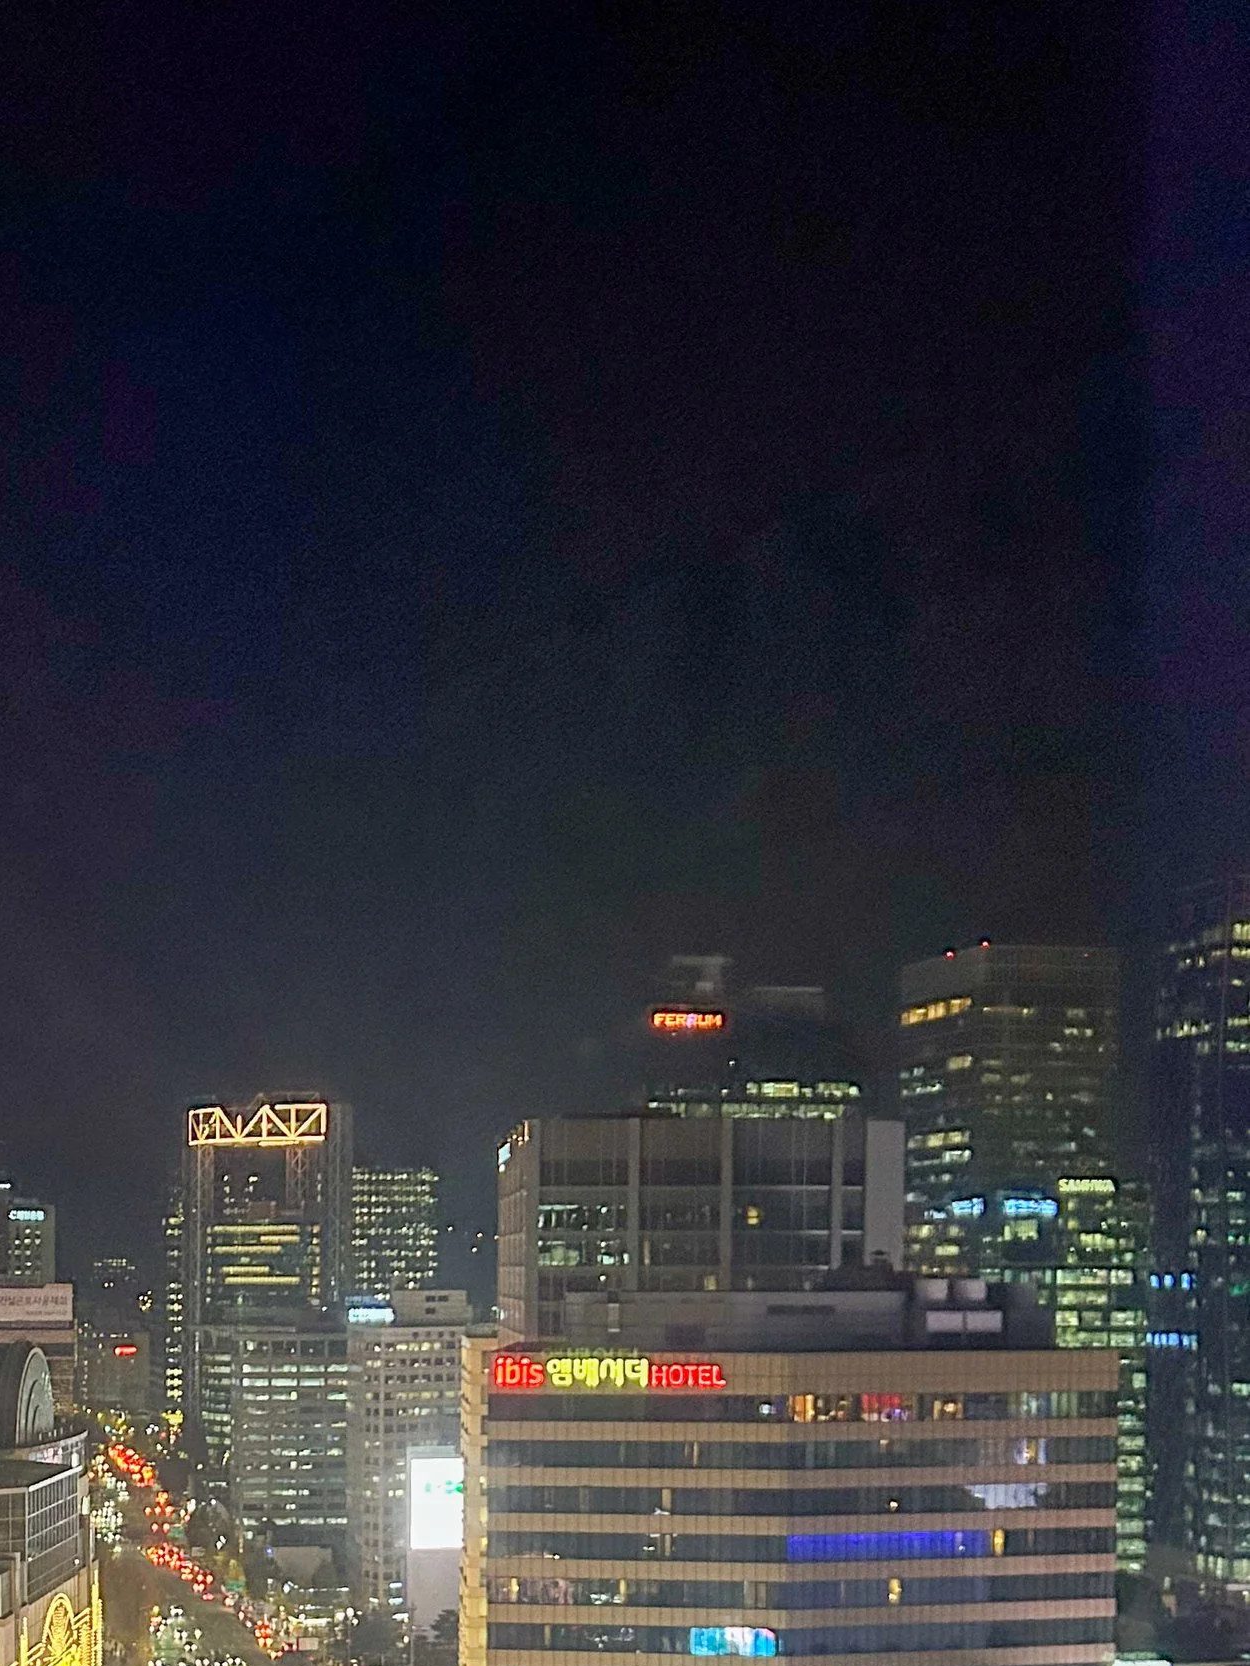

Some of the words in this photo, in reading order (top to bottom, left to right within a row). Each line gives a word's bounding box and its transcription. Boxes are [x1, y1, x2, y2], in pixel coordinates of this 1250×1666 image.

[653, 1013, 722, 1029] FERRUM
[495, 1357, 544, 1387] ibis
[651, 1364, 727, 1388] HOTEL
